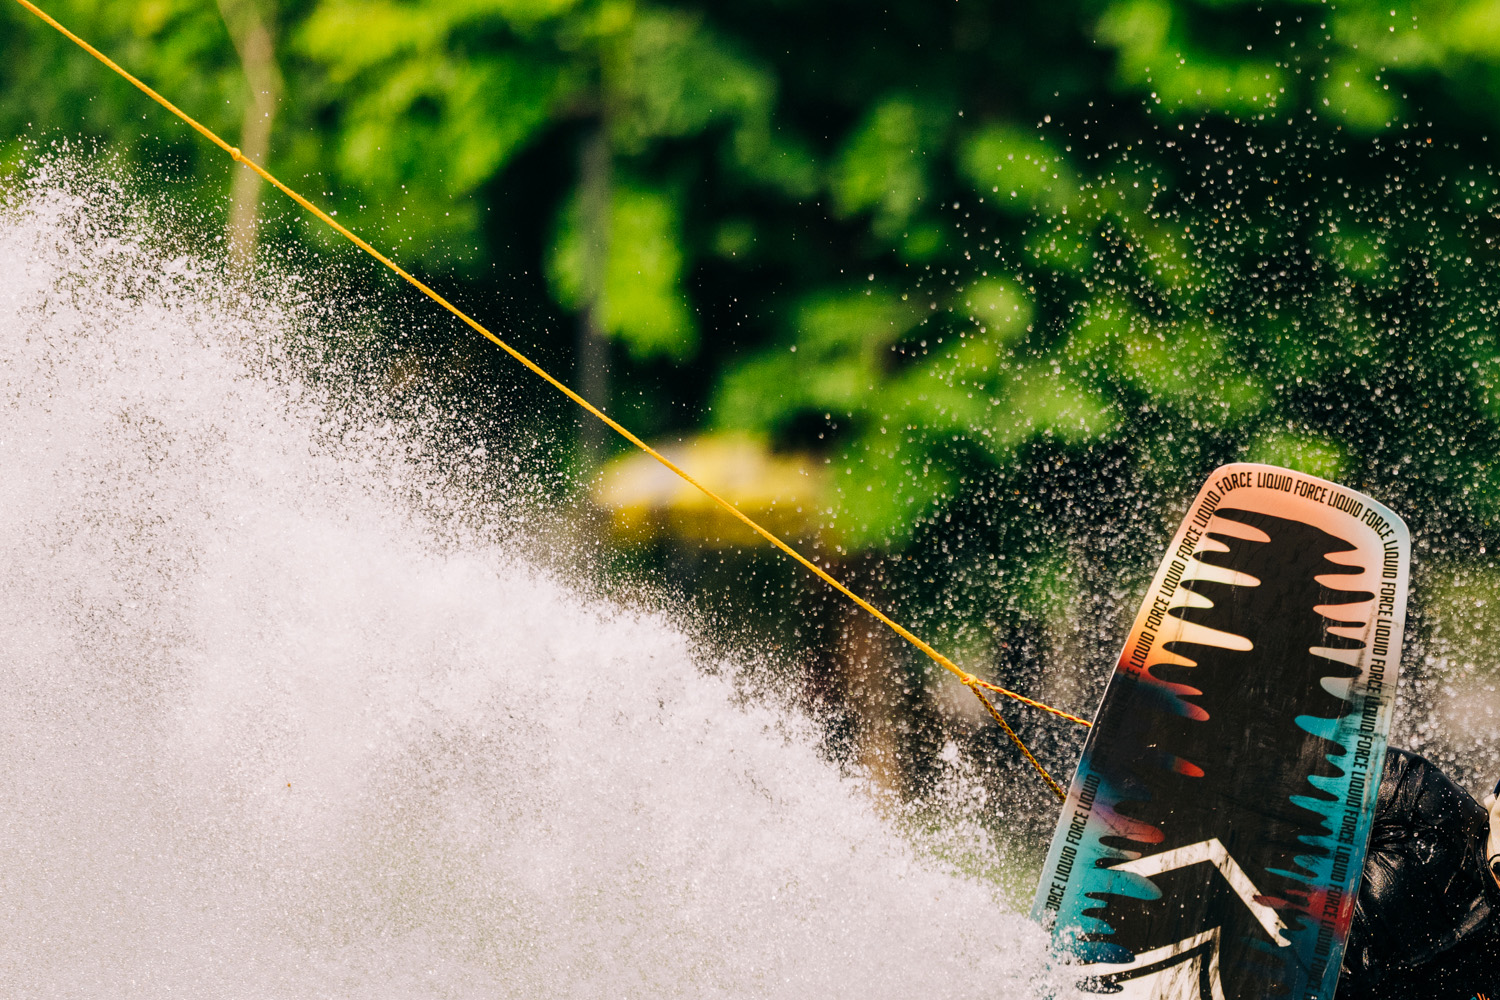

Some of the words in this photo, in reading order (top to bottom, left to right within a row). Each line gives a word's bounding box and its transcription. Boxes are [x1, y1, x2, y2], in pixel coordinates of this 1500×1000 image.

[1215, 472, 1252, 496] FORCE
[1257, 472, 1293, 493] LIQUID
[1294, 480, 1328, 504] FORCE
[1192, 490, 1221, 528] LIQUID
[1327, 491, 1364, 518] LIQUID
[1360, 508, 1394, 541] FORCE
[1176, 525, 1203, 562] FORCE
[1382, 540, 1399, 579] LIQUID
[1160, 560, 1186, 598] LIQUID
[1145, 596, 1171, 633] FORCE
[1378, 581, 1397, 617] FORCE
[1129, 631, 1155, 669] LIQUID
[1372, 618, 1392, 656] LIQUID
[1366, 658, 1386, 694] FORCE
[1360, 695, 1380, 733] LIQUID
[1353, 733, 1373, 770] FORCE
[1077, 774, 1101, 811] LIQUID
[1345, 770, 1366, 808] LIQUID
[1065, 810, 1089, 846] FORCE
[1338, 808, 1359, 845] FORCE
[1053, 845, 1078, 883] LIQUID
[1330, 845, 1352, 882] LIQUID
[1044, 881, 1066, 914] ORCE
[1322, 883, 1343, 919] FORCE
